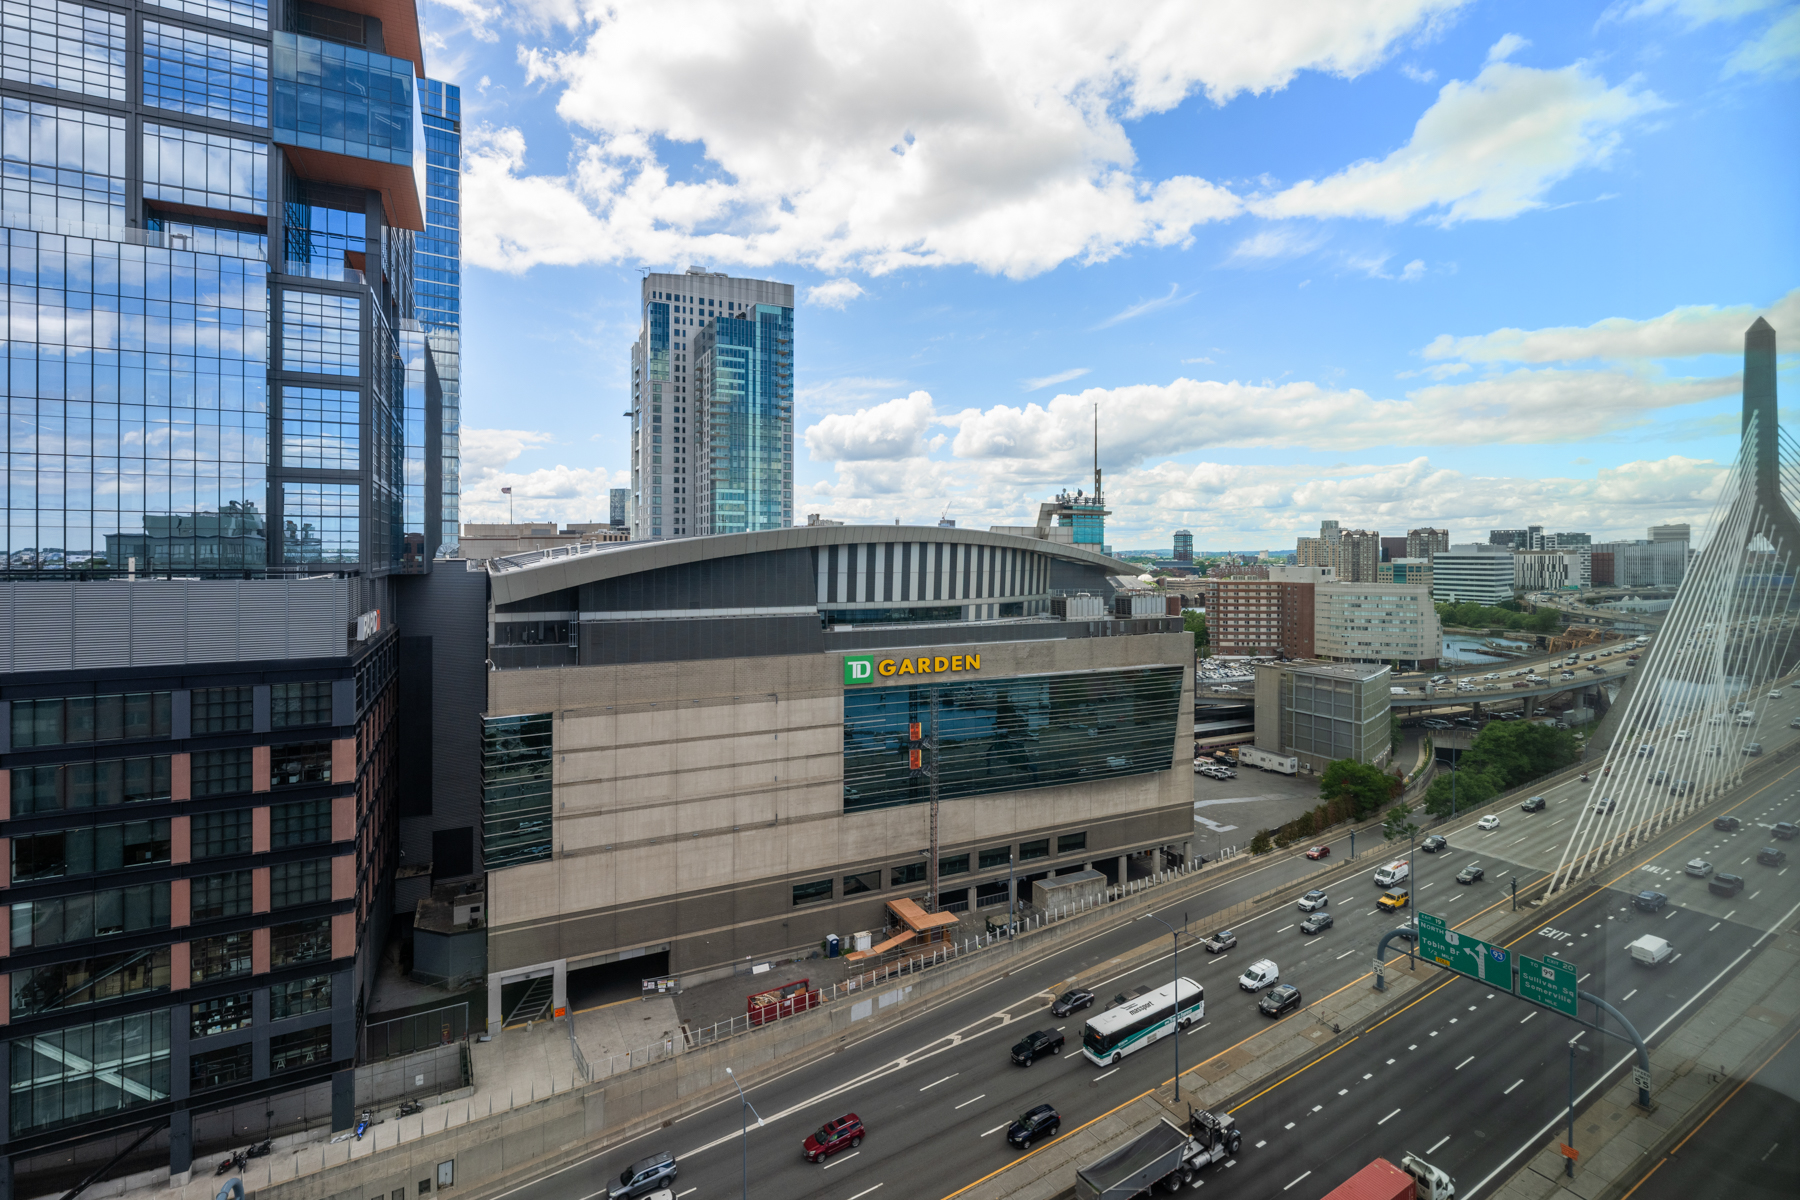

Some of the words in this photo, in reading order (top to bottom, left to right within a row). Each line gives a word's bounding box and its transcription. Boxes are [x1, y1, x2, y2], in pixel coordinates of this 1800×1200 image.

[848, 660, 871, 679] TD
[878, 654, 981, 676] GARDEN
[1641, 864, 1670, 875] ONLY
[1421, 921, 1445, 935] NORTH
[1538, 926, 1572, 941] EXIT
[1422, 937, 1446, 951] Tobin
[1450, 947, 1460, 956] Br
[1441, 953, 1454, 961] MILE
[1492, 950, 1503, 960] 93
[1373, 966, 1384, 975] 55
[1546, 958, 1559, 966] EXIT
[1562, 963, 1574, 971] 20
[1543, 968, 1553, 977] 99
[1523, 973, 1557, 990] Sullivan
[1562, 987, 1574, 998] Sq
[1525, 981, 1572, 1004] Somerville
[1129, 1001, 1154, 1015] massport
[1545, 998, 1558, 1007] MILE
[1634, 1067, 1651, 1078] SPEED
[1635, 1073, 1649, 1081] LIMIT
[1635, 1077, 1649, 1089] 55
